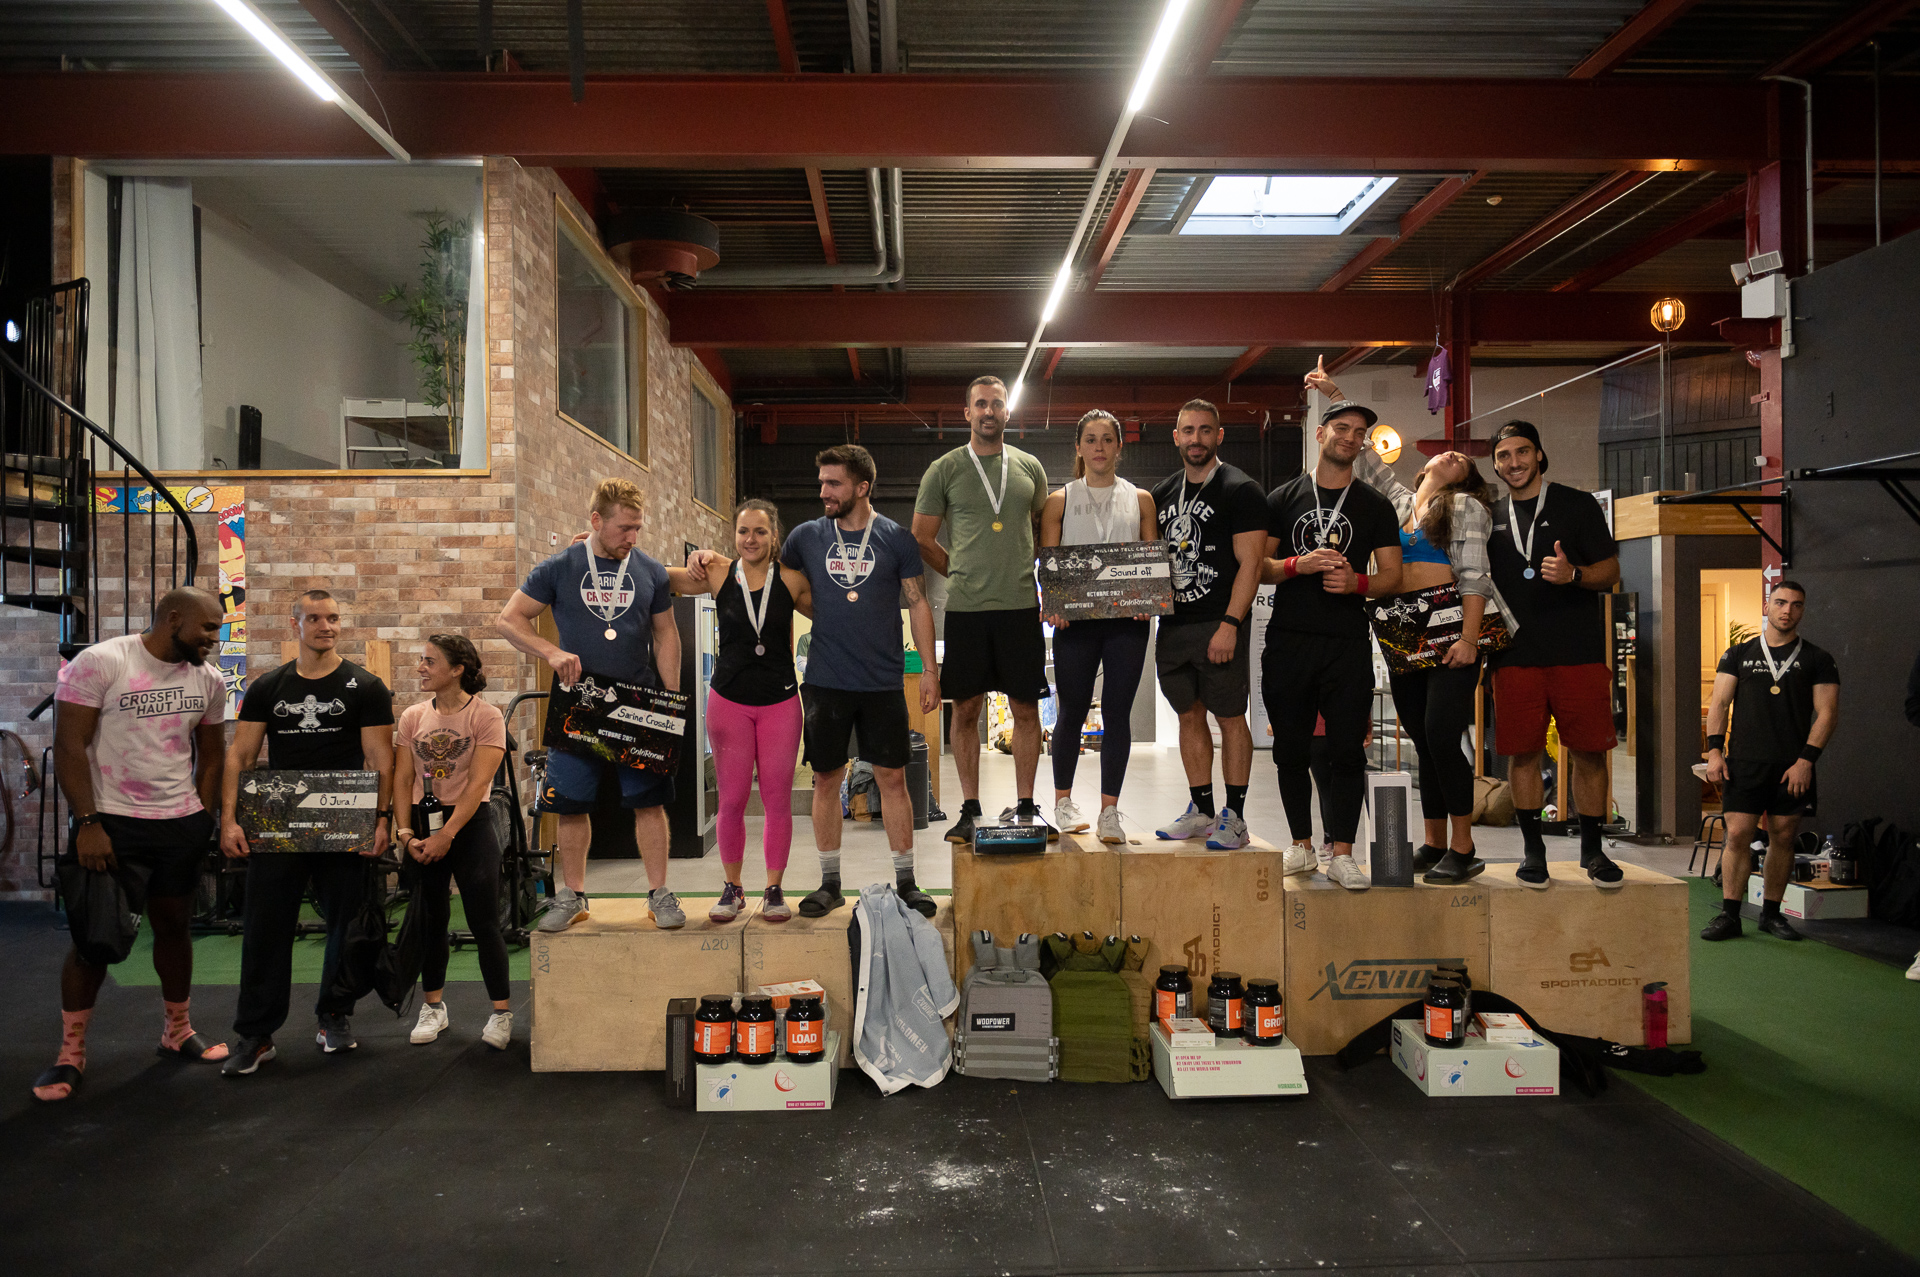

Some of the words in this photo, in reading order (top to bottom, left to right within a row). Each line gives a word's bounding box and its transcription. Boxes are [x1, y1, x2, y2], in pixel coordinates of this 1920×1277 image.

[836, 547, 865, 558] SRIN
[1109, 566, 1138, 577] Sound
[1140, 566, 1152, 577] off
[616, 681, 643, 691] WILLIAM
[644, 687, 658, 695] TELL
[659, 690, 688, 701] CONTEST
[119, 690, 185, 708] CROSSFIT
[136, 702, 173, 715] HAUT
[176, 699, 204, 710] JURA
[617, 708, 644, 723] Sarine
[645, 714, 676, 731] Crossfit
[1540, 977, 1642, 989] SPORTADDICT
[791, 1033, 818, 1044] LOAD
